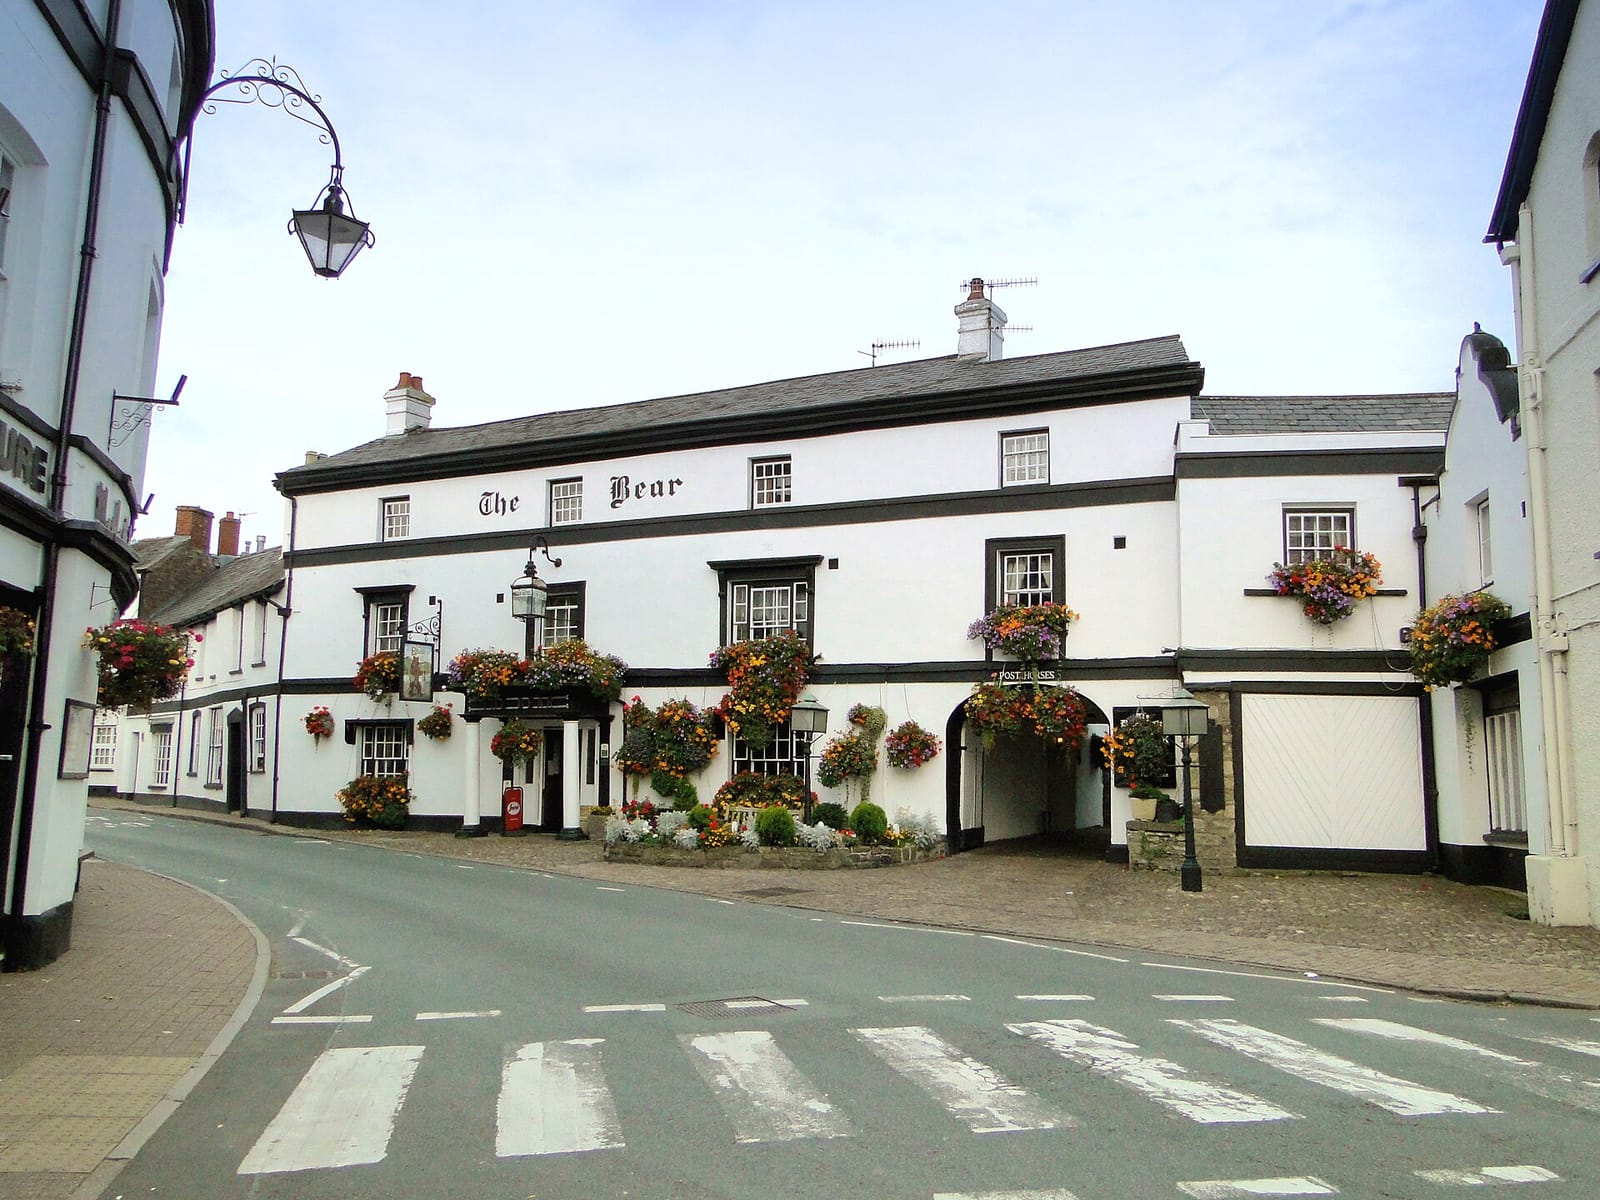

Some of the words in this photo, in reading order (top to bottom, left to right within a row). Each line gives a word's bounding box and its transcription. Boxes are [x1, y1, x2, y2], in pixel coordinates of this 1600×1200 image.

[479, 490, 521, 517] The
[609, 475, 684, 509] Bear
[999, 671, 1021, 680] POST
